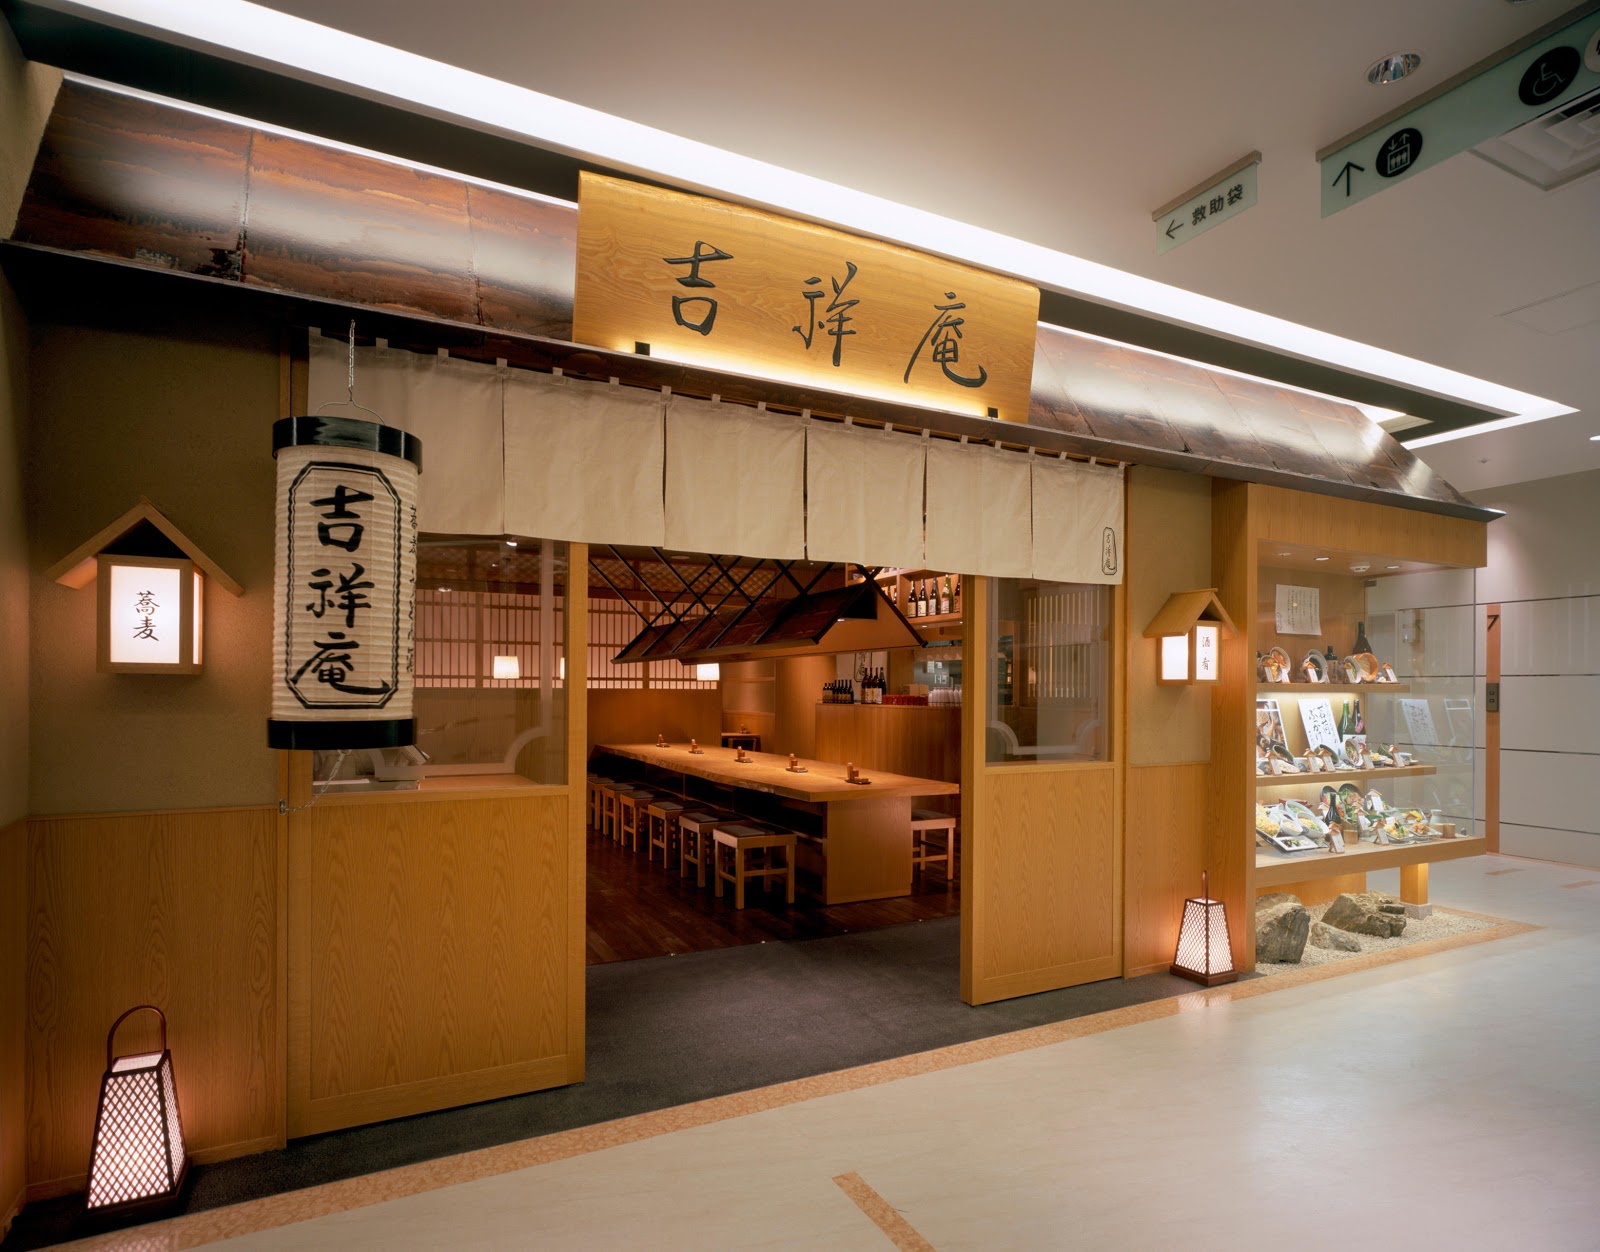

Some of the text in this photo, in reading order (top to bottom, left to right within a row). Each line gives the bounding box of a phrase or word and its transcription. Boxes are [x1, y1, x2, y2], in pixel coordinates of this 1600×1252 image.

[1192, 184, 1243, 226] 救助袋
[662, 240, 988, 388] 吉祥庵
[133, 590, 160, 641] 蕎麦
[290, 485, 392, 695] 吉祥庵
